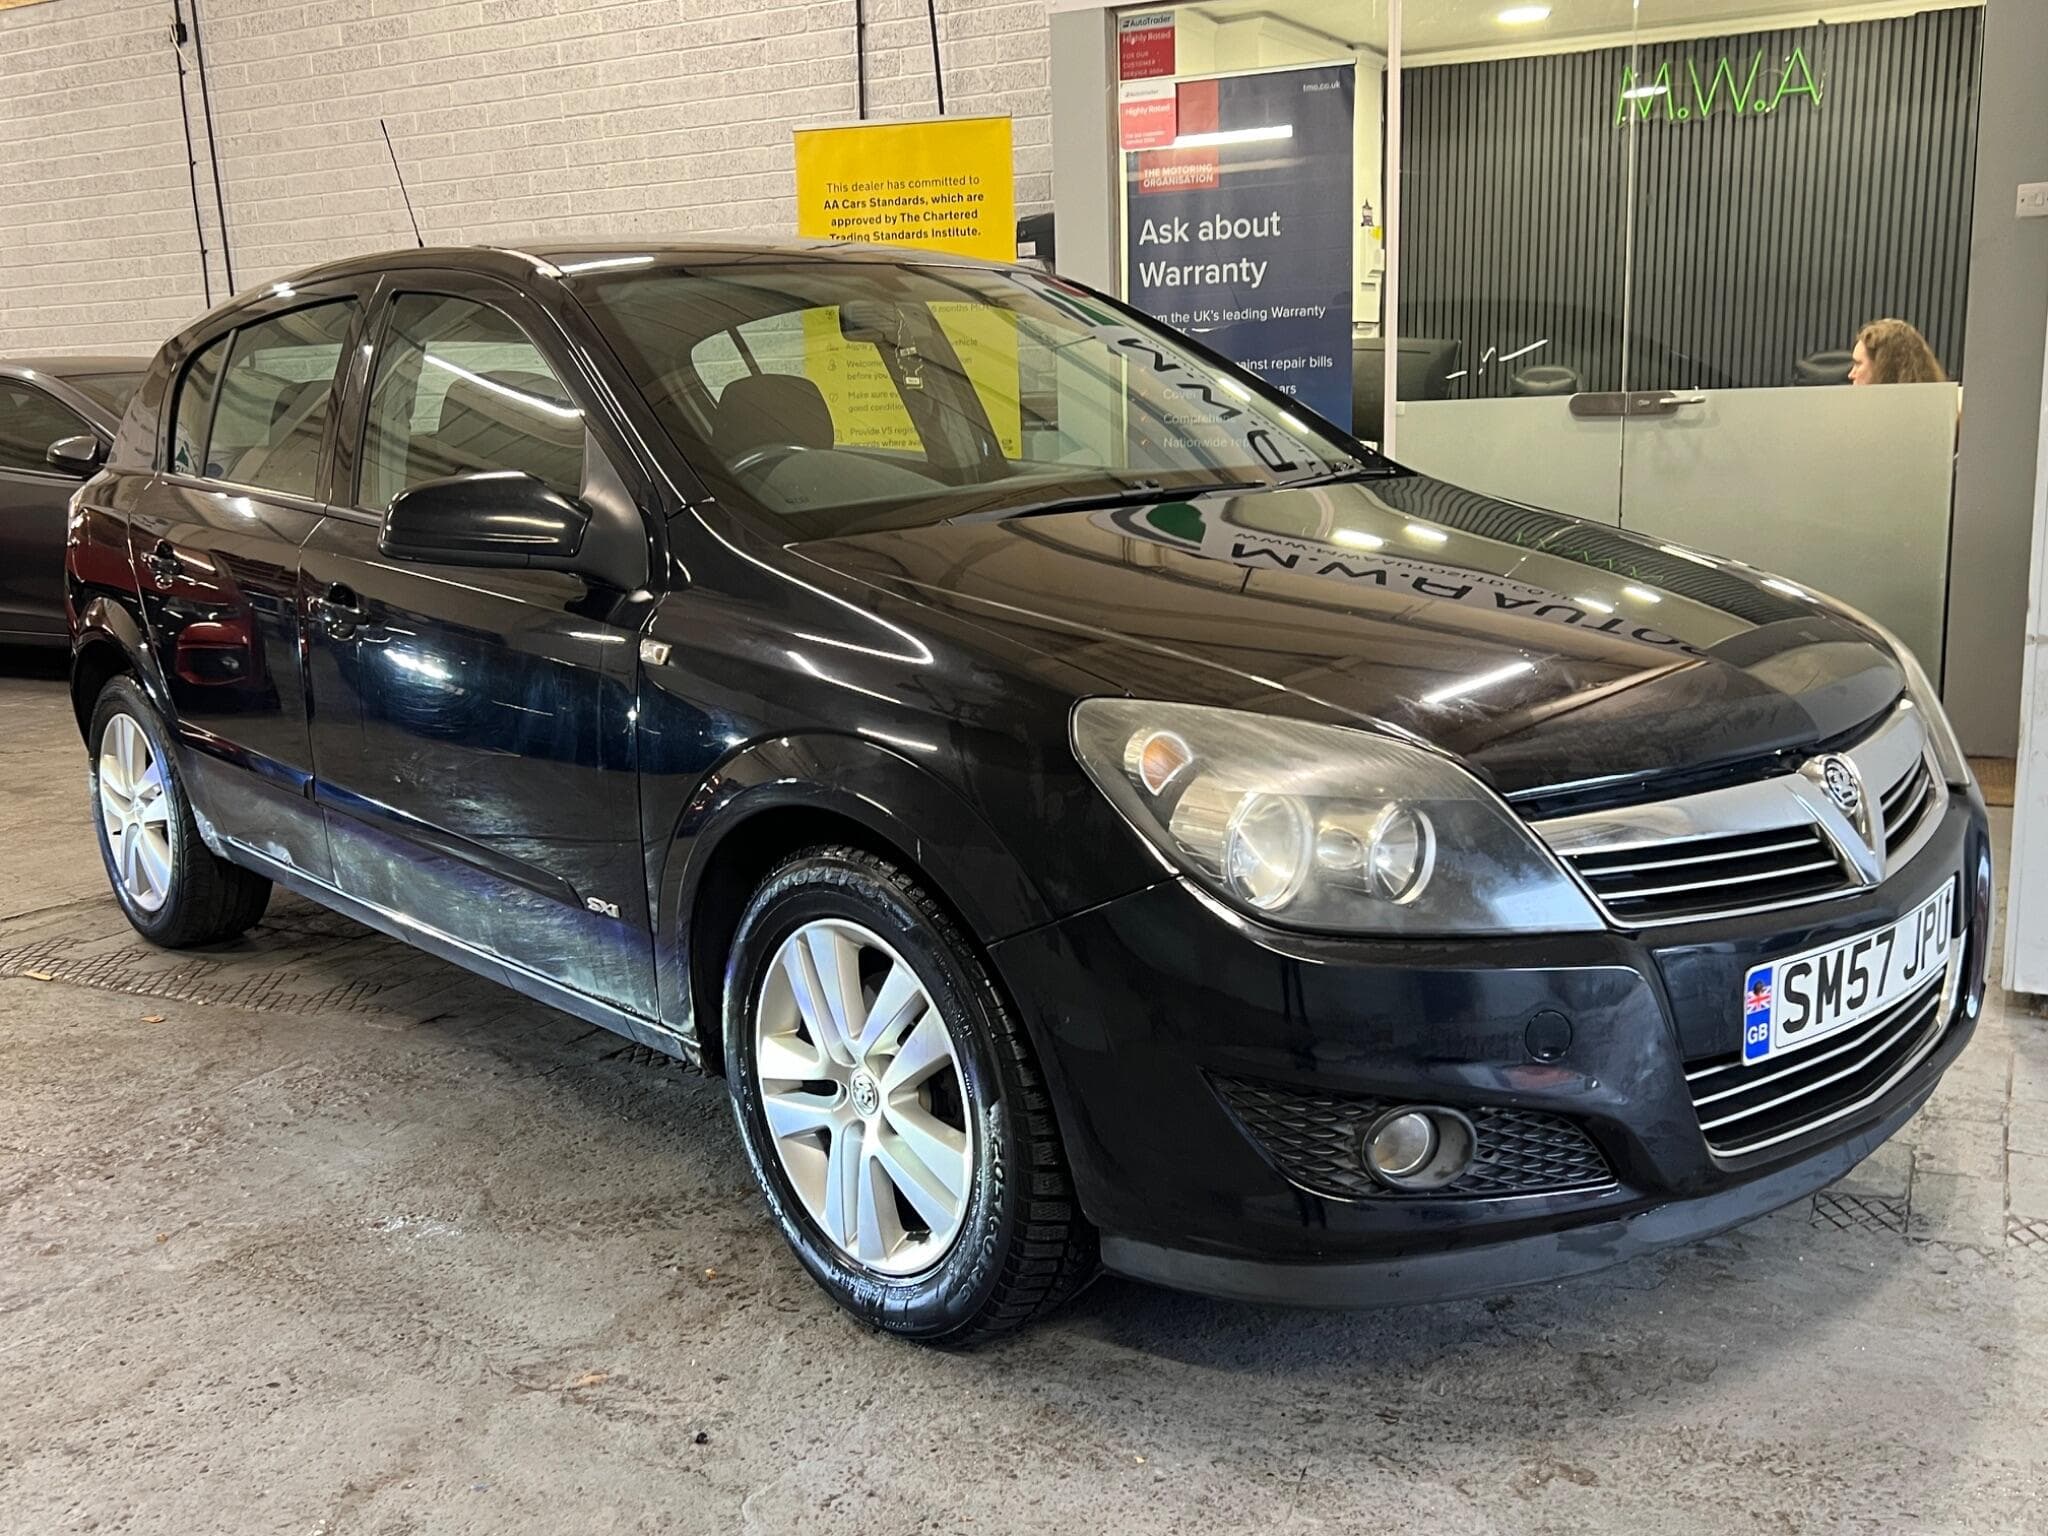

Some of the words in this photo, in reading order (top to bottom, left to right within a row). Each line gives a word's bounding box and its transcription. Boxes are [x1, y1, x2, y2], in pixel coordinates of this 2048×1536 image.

[1144, 167, 1160, 178] THE
[1162, 162, 1213, 177] MOTORING
[826, 182, 848, 194] This
[851, 179, 884, 192] dealer
[887, 178, 905, 190] has
[908, 175, 966, 189] committed
[969, 175, 980, 186] to
[1143, 173, 1214, 188] ORGANISATION
[824, 201, 839, 211] AA
[841, 198, 867, 209] Cars
[869, 194, 929, 208] Standards,
[931, 192, 964, 204] which
[966, 192, 984, 202] are
[831, 214, 882, 229] approved
[884, 213, 898, 226] by
[899, 211, 921, 224] The
[923, 209, 978, 222] Chartered
[1139, 217, 1190, 246] Ask
[1198, 211, 1281, 242] about
[872, 229, 929, 242] Standards
[931, 226, 982, 239] Institute.
[1139, 257, 1268, 289] Warranty
[1171, 311, 1190, 323] the
[1193, 309, 1220, 323] UK's
[1222, 307, 1268, 322] leading
[1271, 304, 1327, 320] Warranty
[1236, 358, 1268, 371] ainst
[1271, 355, 1307, 372] repair
[1309, 354, 1334, 368] bills
[1782, 926, 1896, 1034] SM57
[1903, 886, 1951, 981] JPU
[1747, 1022, 1769, 1045] GB
